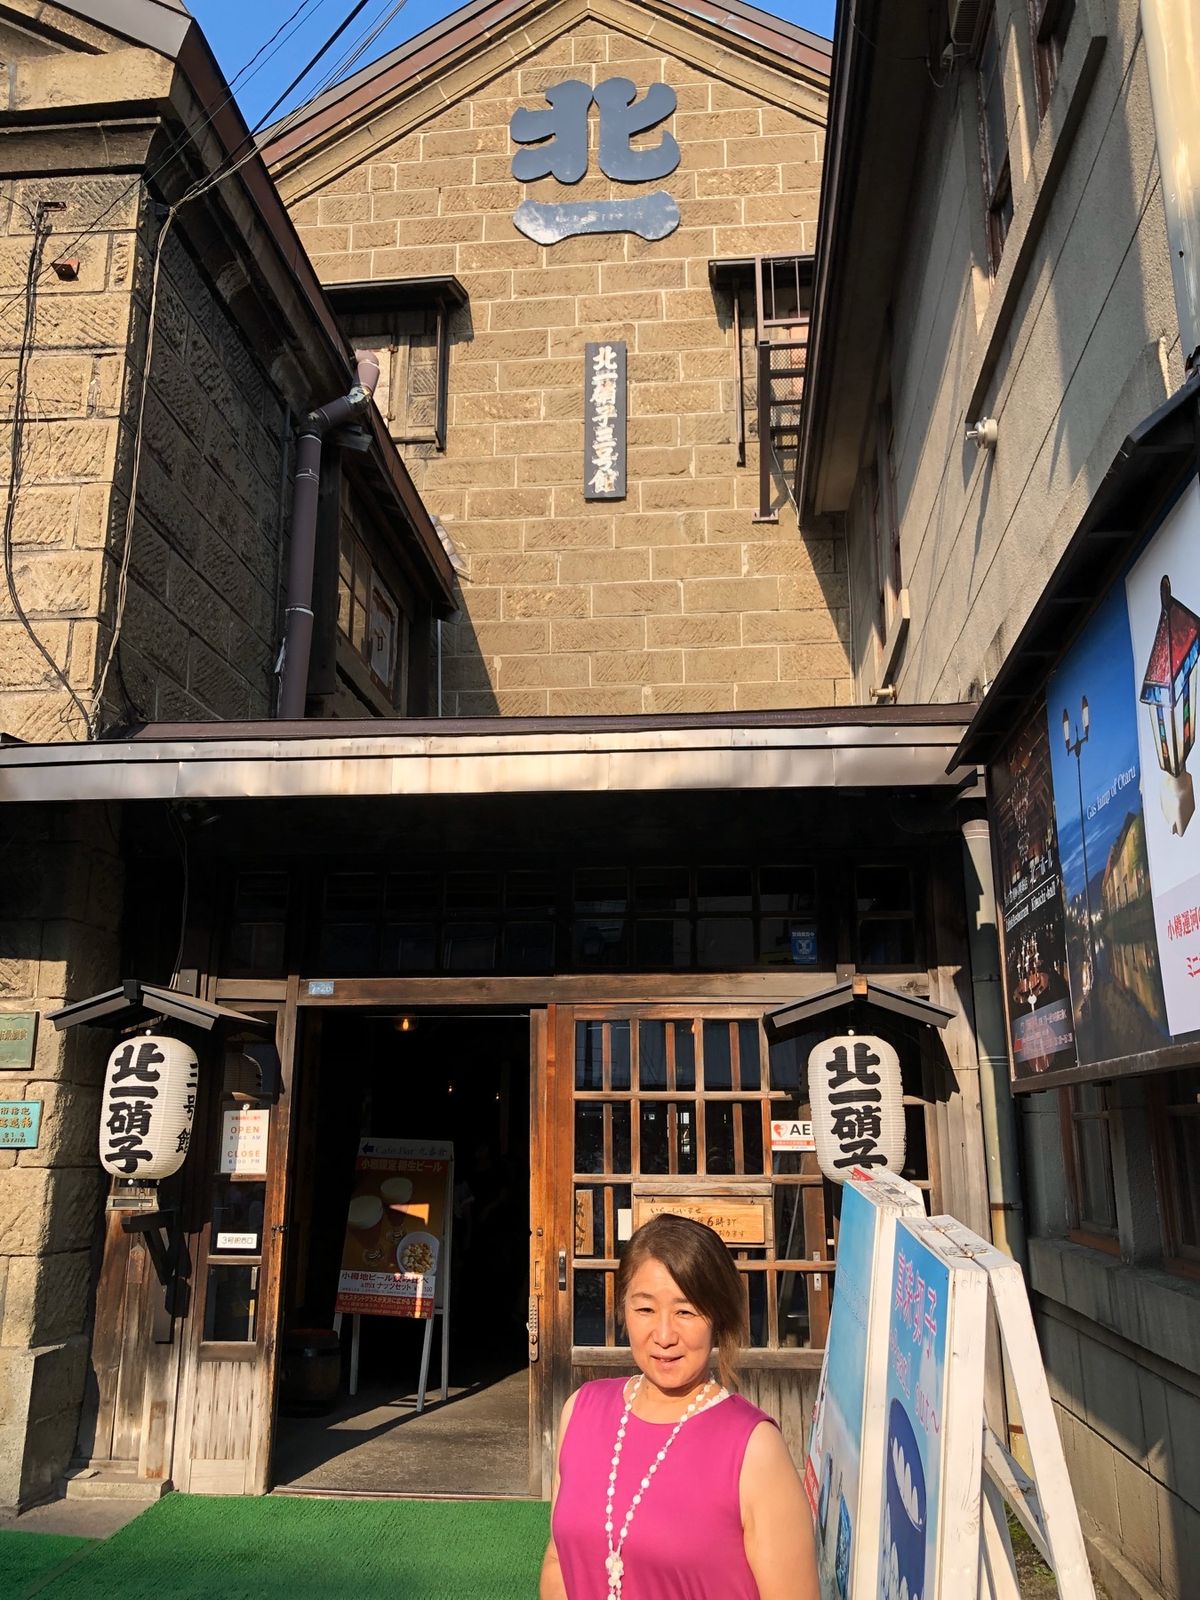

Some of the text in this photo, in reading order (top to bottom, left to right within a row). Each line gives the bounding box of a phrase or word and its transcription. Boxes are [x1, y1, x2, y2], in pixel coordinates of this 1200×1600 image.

[510, 77, 681, 245] 北一
[589, 345, 620, 493] 北一硝子三号館
[1118, 766, 1136, 790] Otaru
[1168, 906, 1200, 941] 小樽運河
[105, 1043, 165, 1173] 北一硝子
[176, 1063, 198, 1152] 三号館
[790, 1124, 811, 1135] AE
[826, 1042, 888, 1169] 北一硝子
